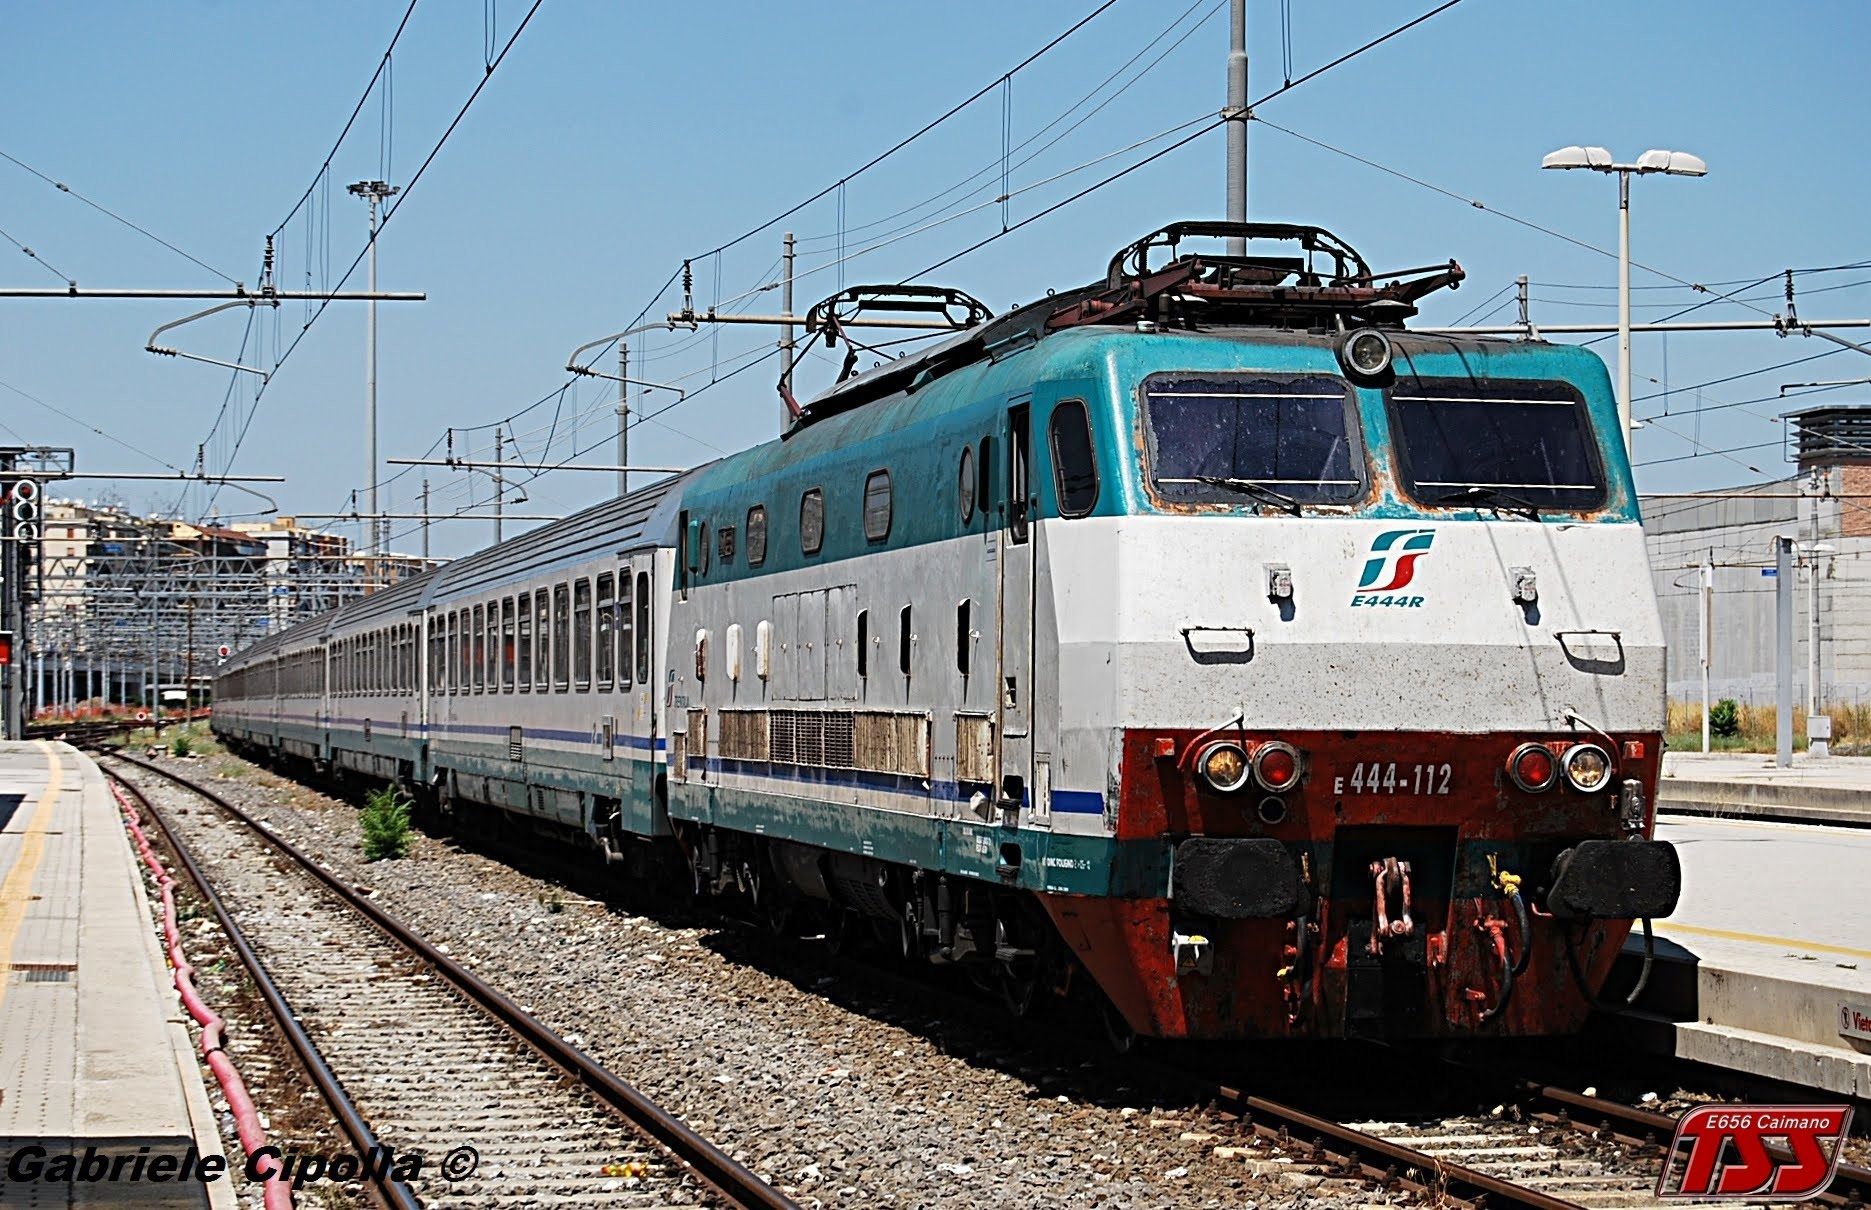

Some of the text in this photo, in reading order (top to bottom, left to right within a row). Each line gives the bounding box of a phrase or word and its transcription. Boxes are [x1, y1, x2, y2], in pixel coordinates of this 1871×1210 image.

[1350, 595, 1425, 608] E444R
[1334, 762, 1452, 795] E 444-112
